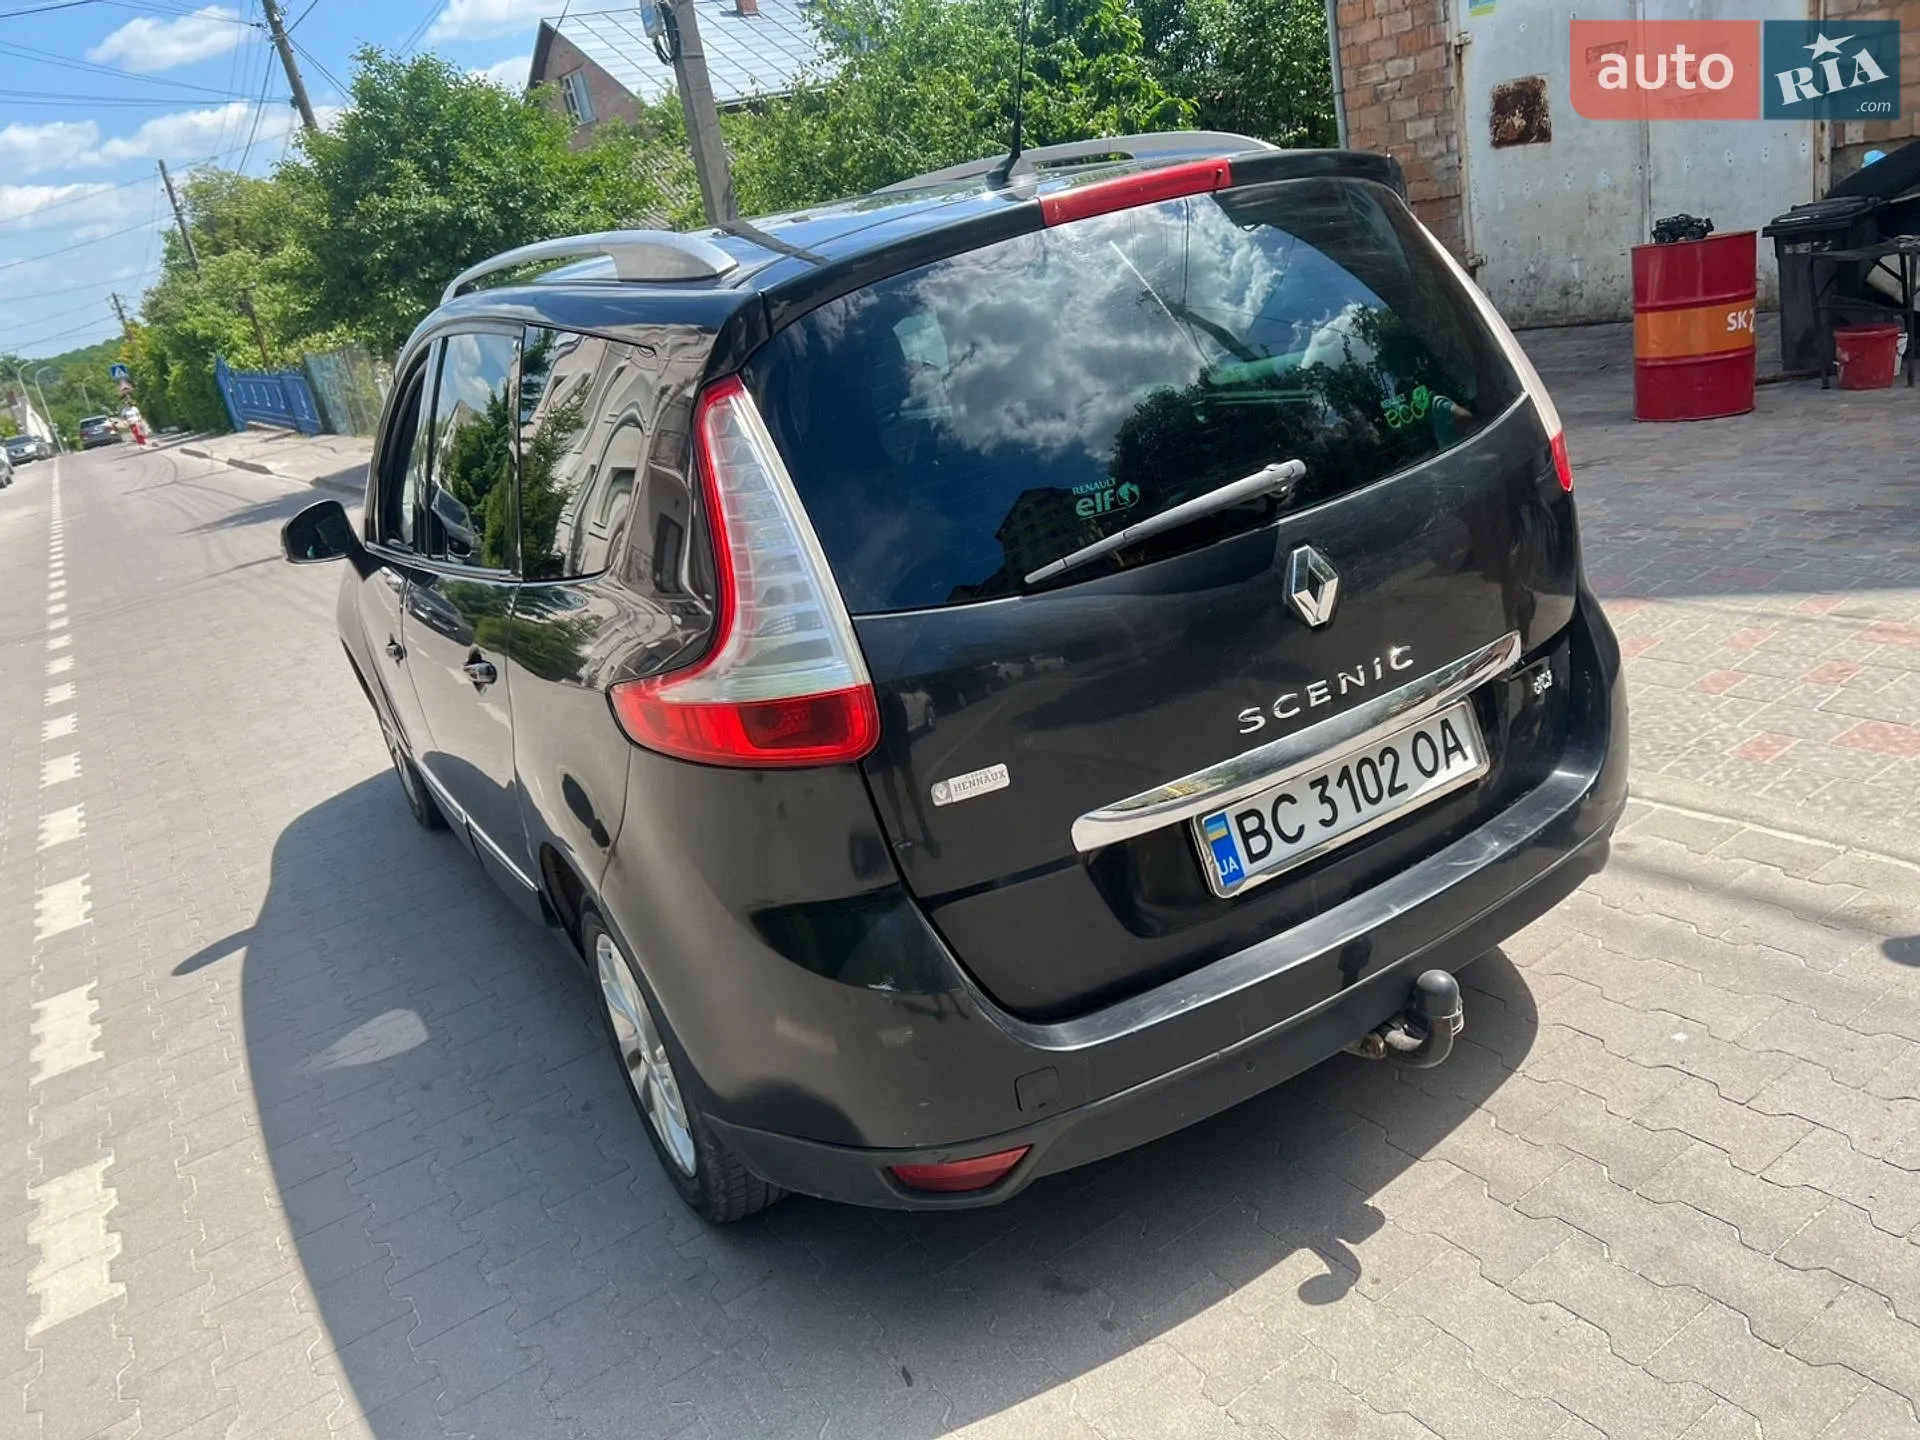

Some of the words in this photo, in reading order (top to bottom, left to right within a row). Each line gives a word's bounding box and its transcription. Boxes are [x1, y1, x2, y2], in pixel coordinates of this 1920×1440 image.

[1072, 477, 1116, 496] RENAULT
[1075, 489, 1115, 517] elf
[953, 769, 1007, 794] HENNAUX
[1235, 794, 1306, 864] BC
[1309, 746, 1409, 828] 3102
[1411, 717, 1469, 778] OA
[1218, 858, 1240, 877] UA
